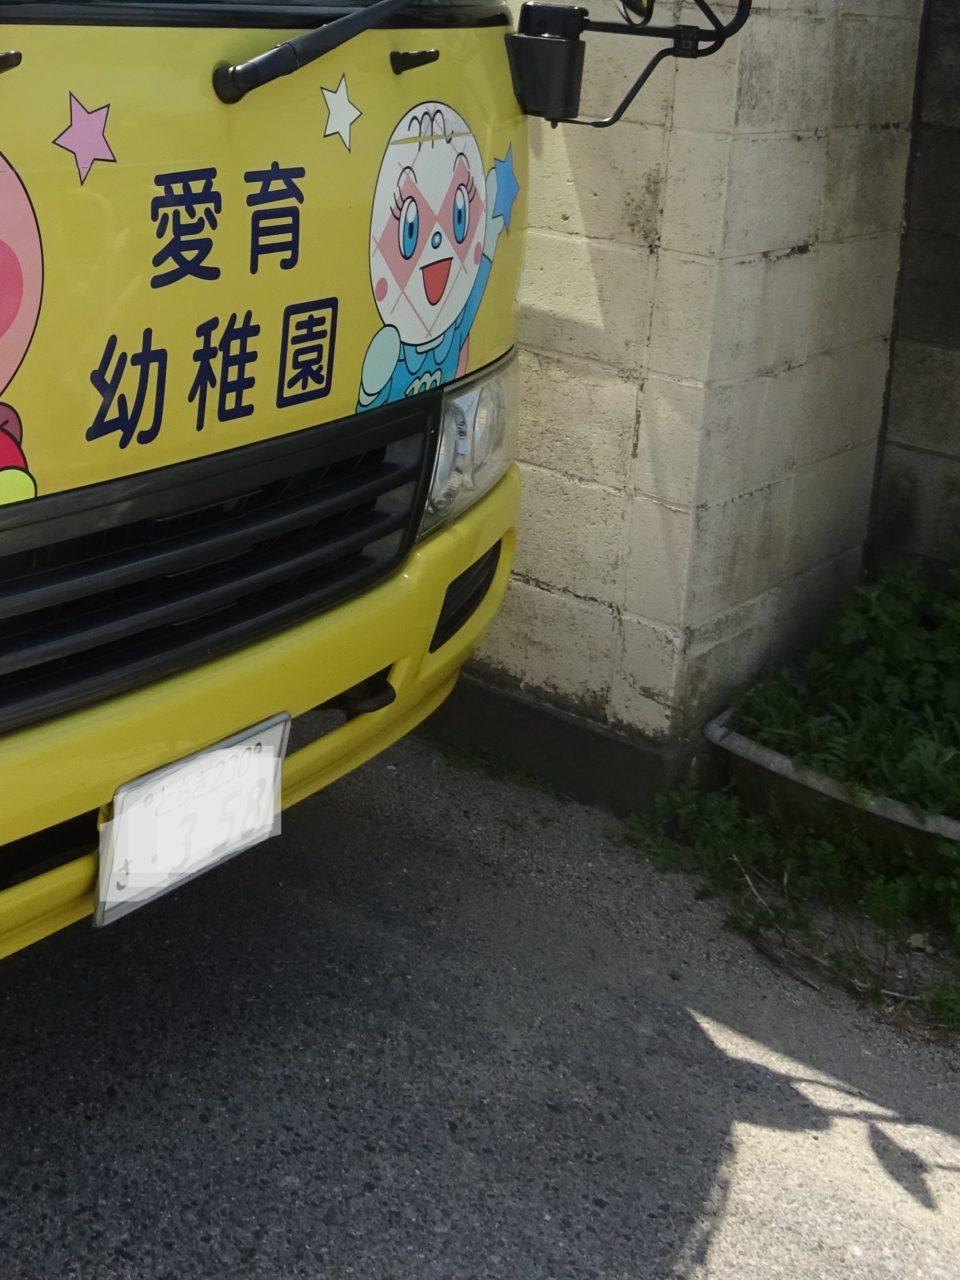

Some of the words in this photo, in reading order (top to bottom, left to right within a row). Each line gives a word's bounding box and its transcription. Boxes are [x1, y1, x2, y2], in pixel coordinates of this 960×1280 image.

[150, 161, 306, 289] 愛育
[86, 297, 338, 449] 幼稚園
